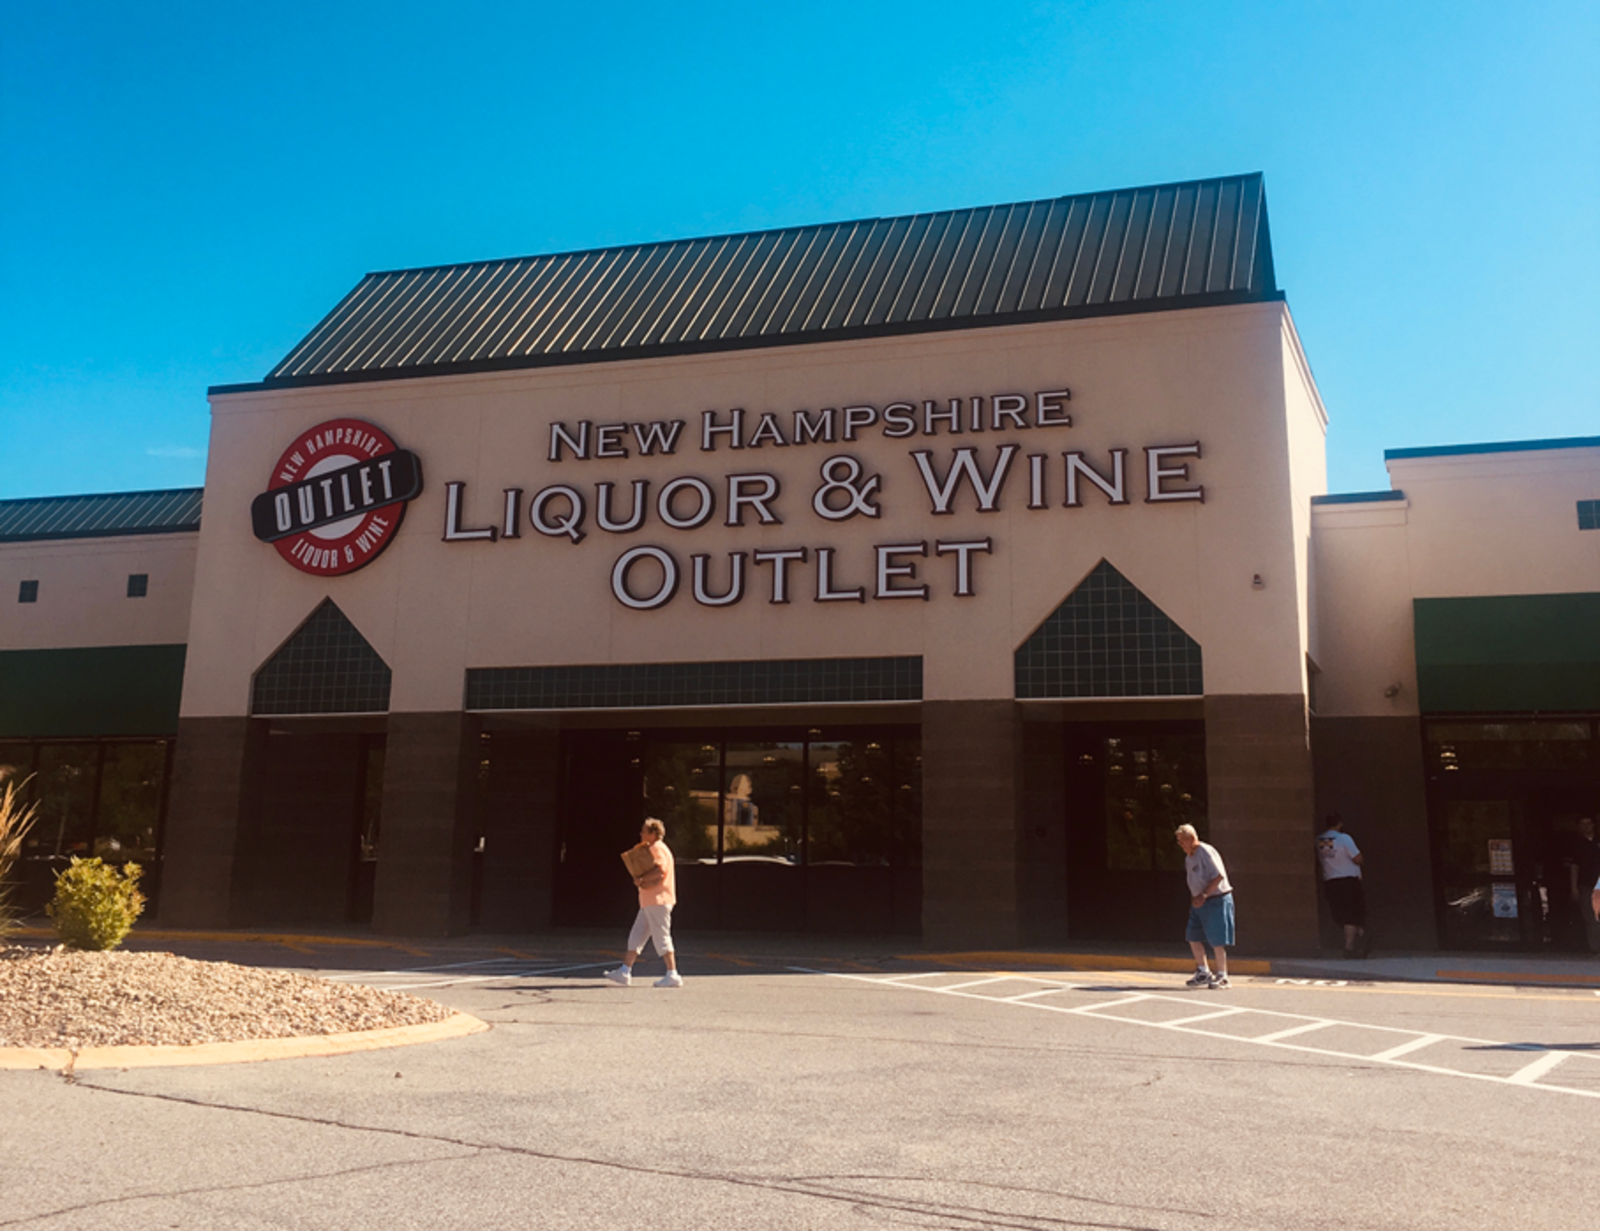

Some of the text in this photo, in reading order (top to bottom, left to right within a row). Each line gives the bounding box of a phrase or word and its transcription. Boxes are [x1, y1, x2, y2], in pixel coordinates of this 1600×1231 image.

[280, 428, 382, 482] NEW HAMPSHIRE
[547, 388, 1072, 462] NEW HAMPSHIRE
[274, 460, 392, 532] OUTLET
[442, 440, 1205, 544] LIQUOR & WINE
[291, 515, 388, 568] LIQUOR & WINE
[610, 537, 993, 610] OUTLET
